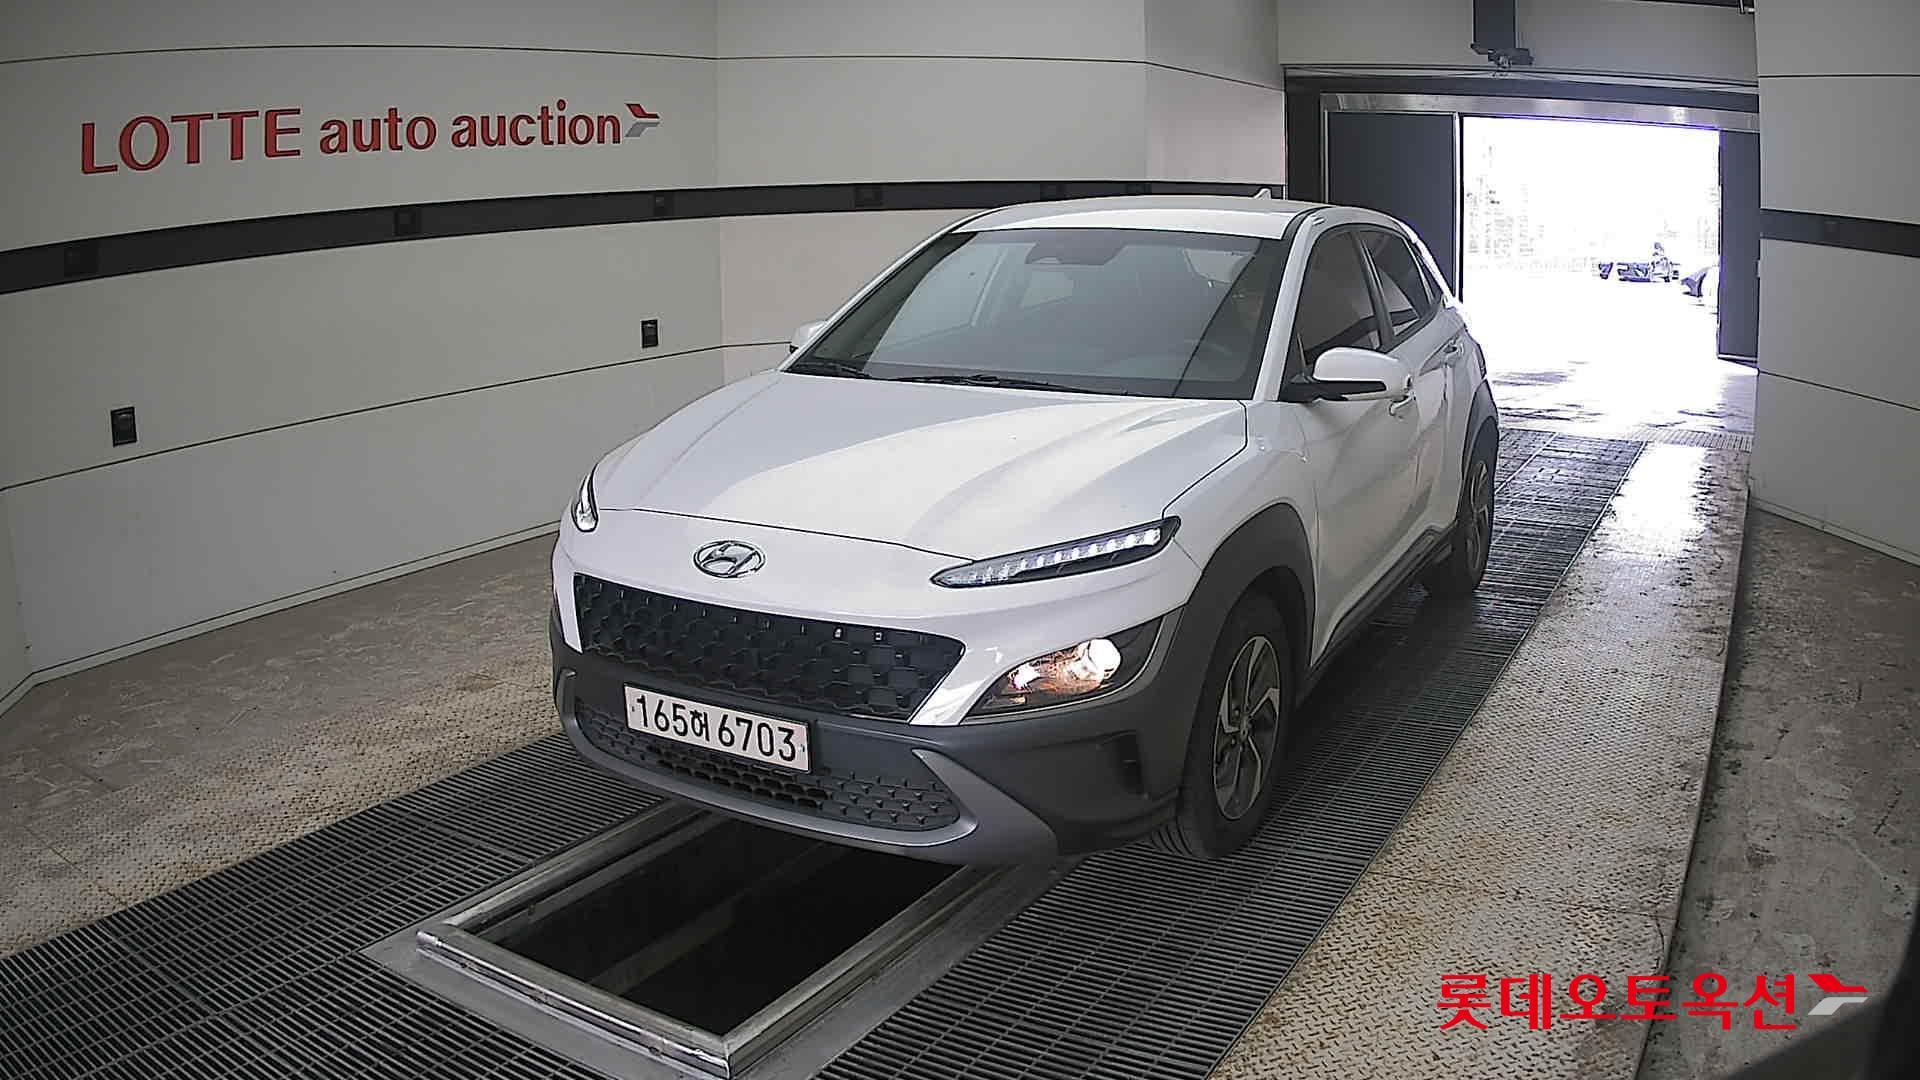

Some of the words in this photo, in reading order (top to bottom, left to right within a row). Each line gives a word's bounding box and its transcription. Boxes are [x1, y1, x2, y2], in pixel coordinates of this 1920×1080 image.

[82, 110, 301, 174] LOTTE
[319, 107, 437, 154] auto
[451, 99, 622, 148] auction
